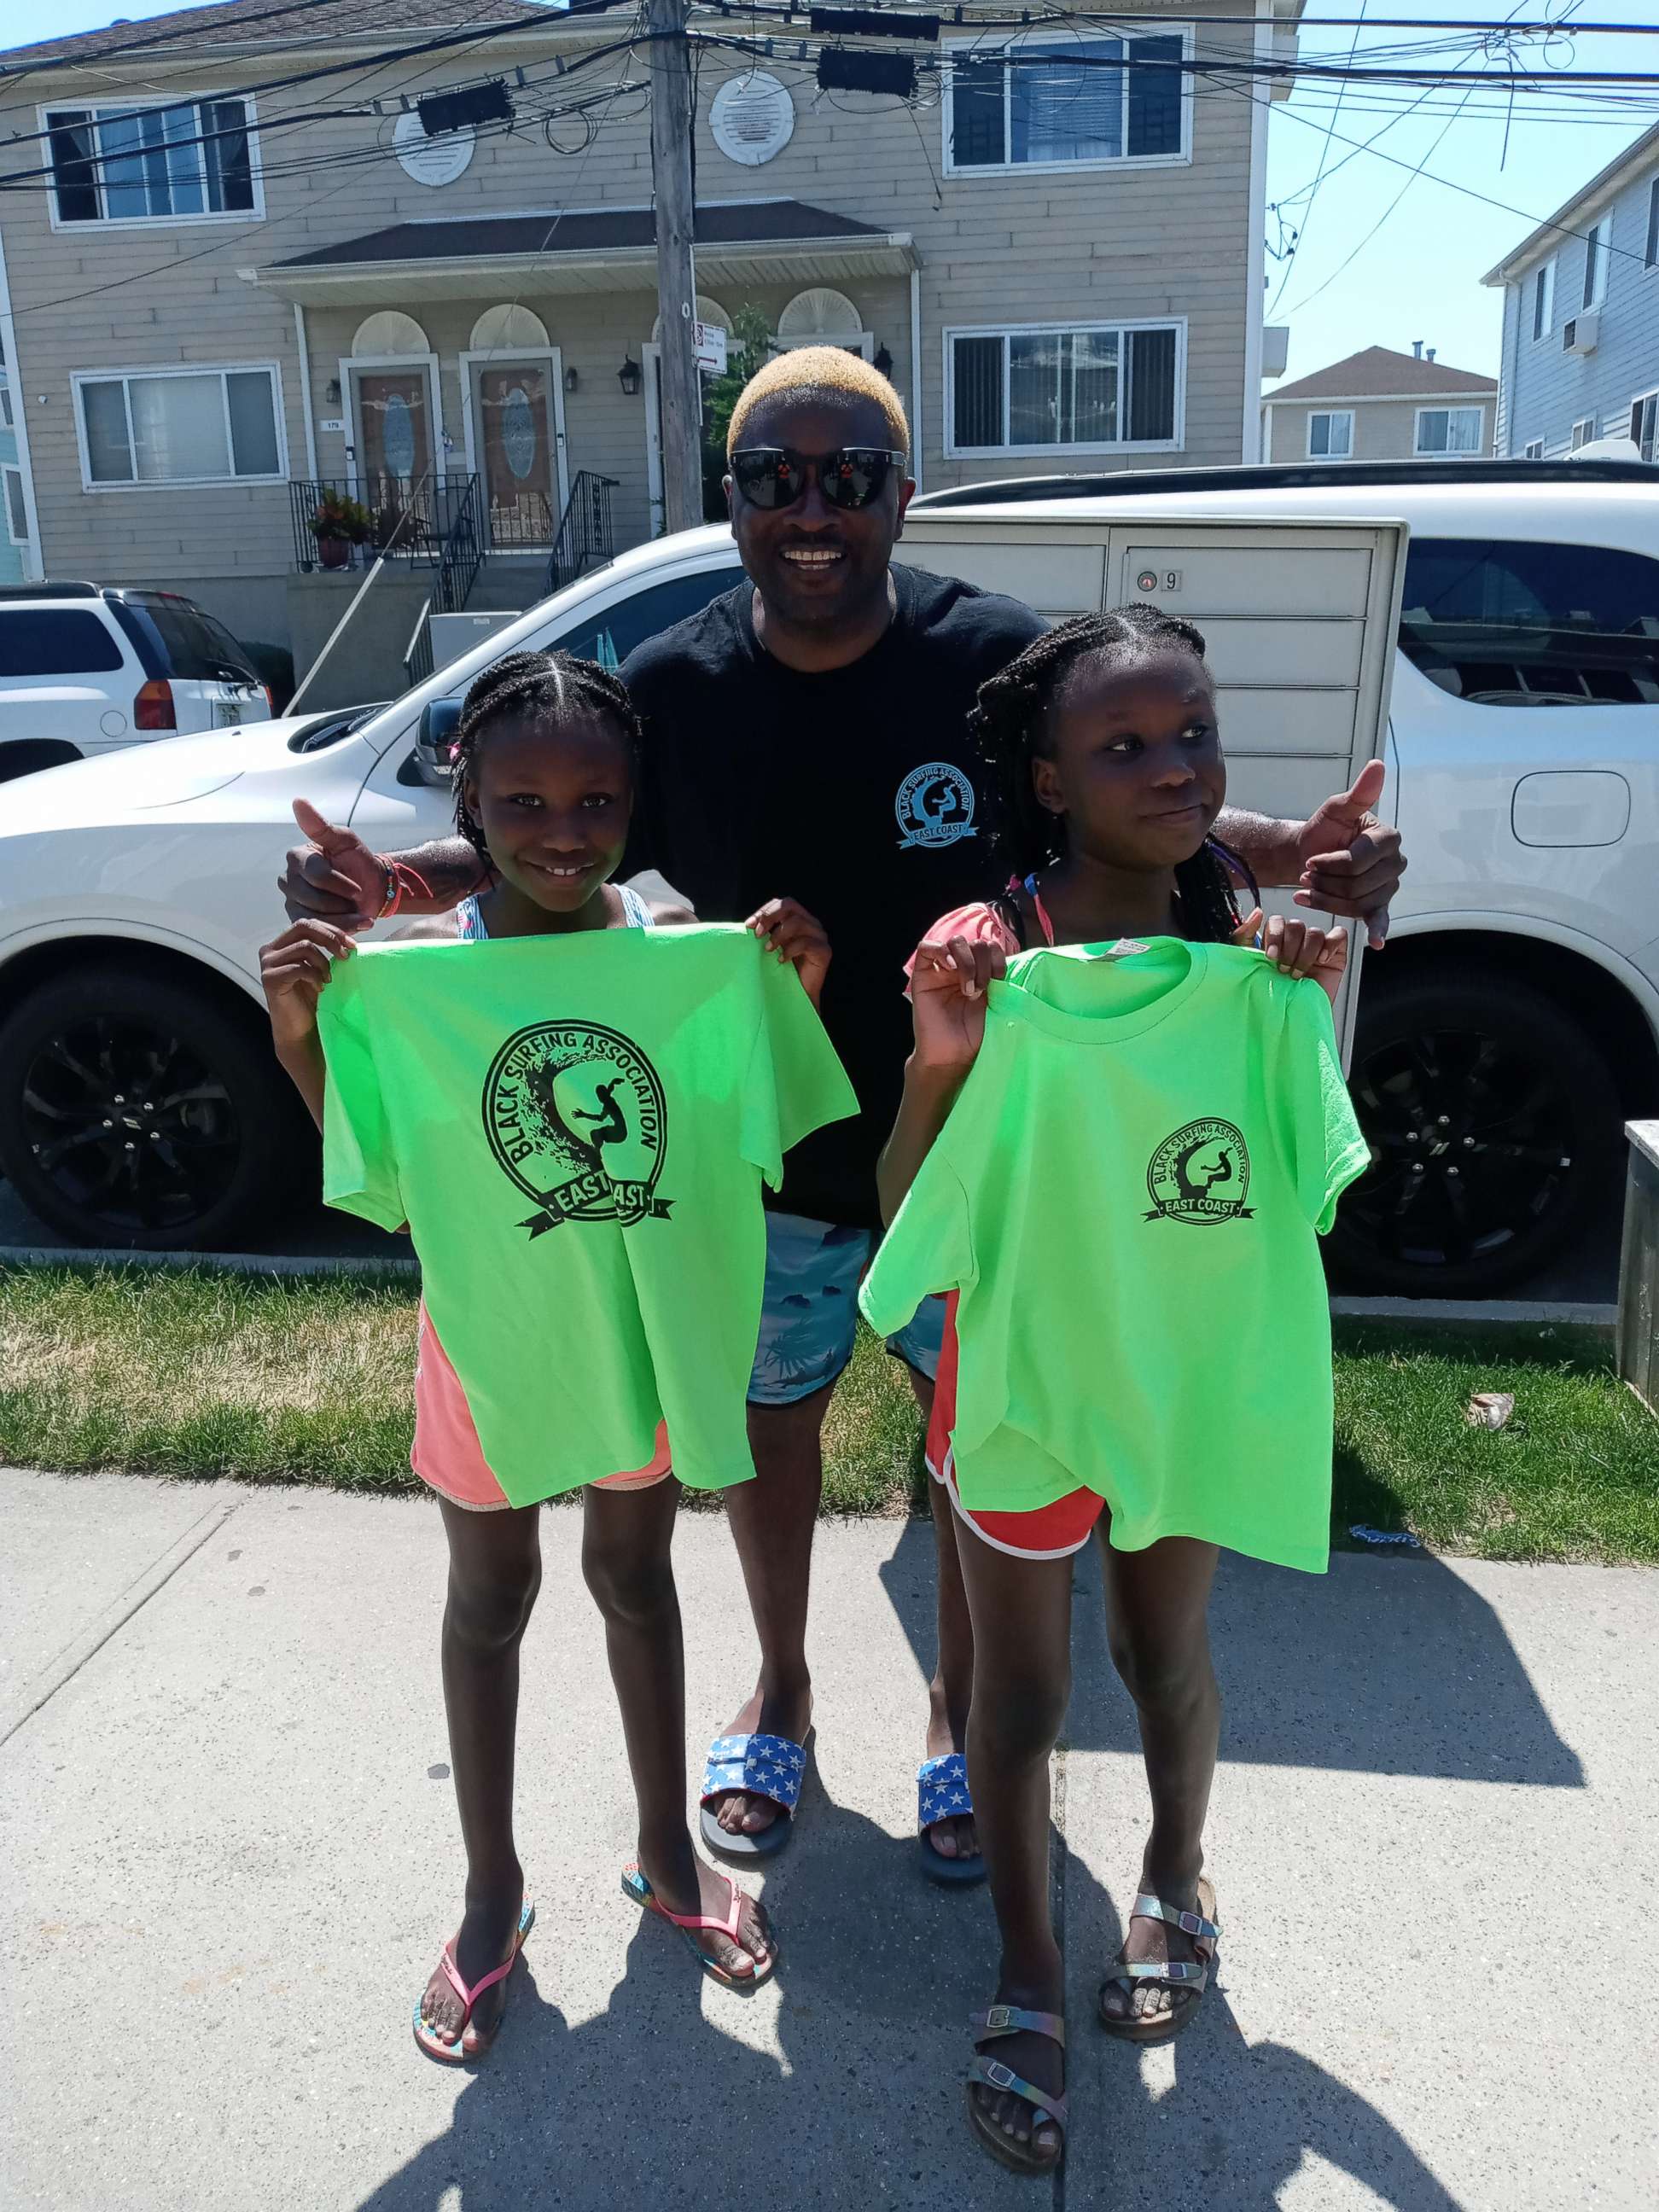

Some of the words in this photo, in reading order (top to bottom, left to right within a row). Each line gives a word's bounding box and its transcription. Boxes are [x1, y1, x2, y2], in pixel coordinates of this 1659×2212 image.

[1167, 573, 1176, 590] 9
[901, 789, 912, 819] BLACK
[909, 768, 939, 789] SURFING
[940, 769, 969, 811] ASSOCIATION
[915, 826, 936, 840] EAST
[936, 824, 963, 835] COAST
[504, 1033, 577, 1080] SURFING
[583, 1034, 657, 1151] ASSOCIATION
[497, 1085, 533, 1164] BLACK
[1154, 1148, 1175, 1185] BLACK
[1172, 1124, 1213, 1149] SURFING
[1214, 1125, 1246, 1184] ASSOCIATION
[554, 1170, 609, 1211] EAST
[1165, 1198, 1195, 1213] EAST
[1197, 1198, 1237, 1214] COAST
